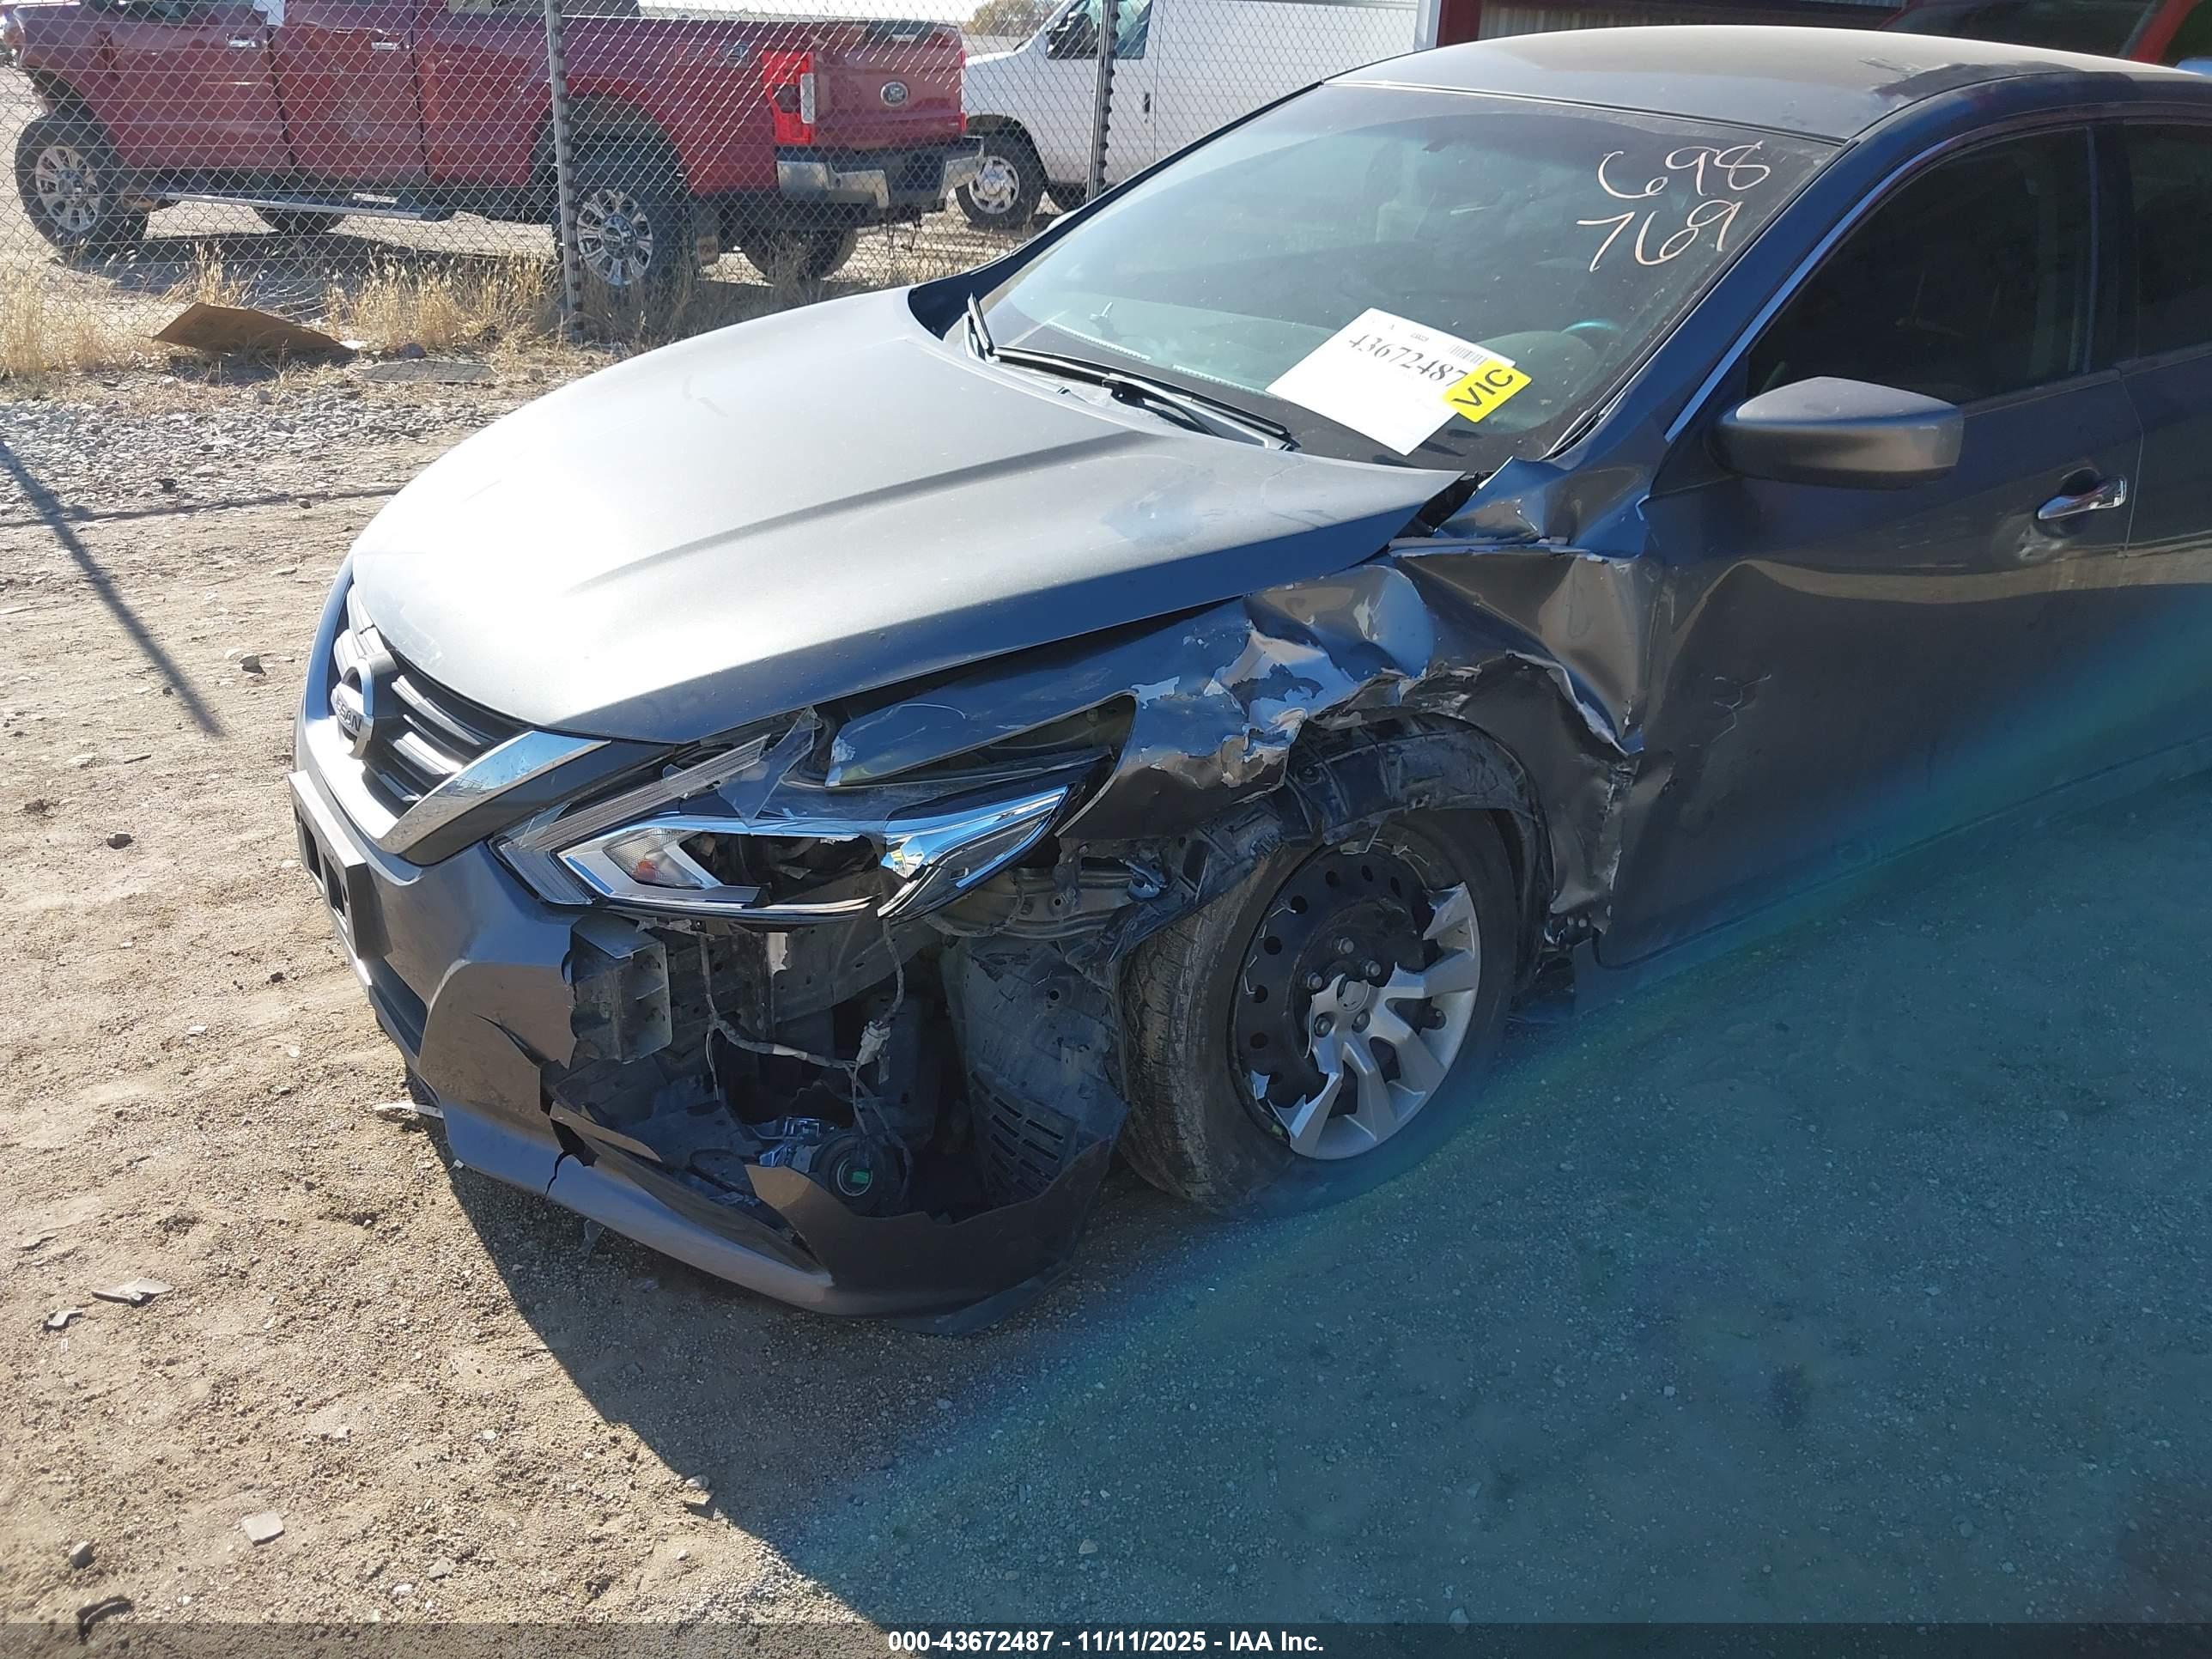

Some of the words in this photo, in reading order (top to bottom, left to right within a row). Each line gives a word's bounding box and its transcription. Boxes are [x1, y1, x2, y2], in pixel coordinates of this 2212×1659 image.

[1597, 139, 1771, 199] 698
[1576, 199, 1744, 273] 769
[1348, 334, 1469, 387] 43672487
[1452, 368, 1514, 407] VIC
